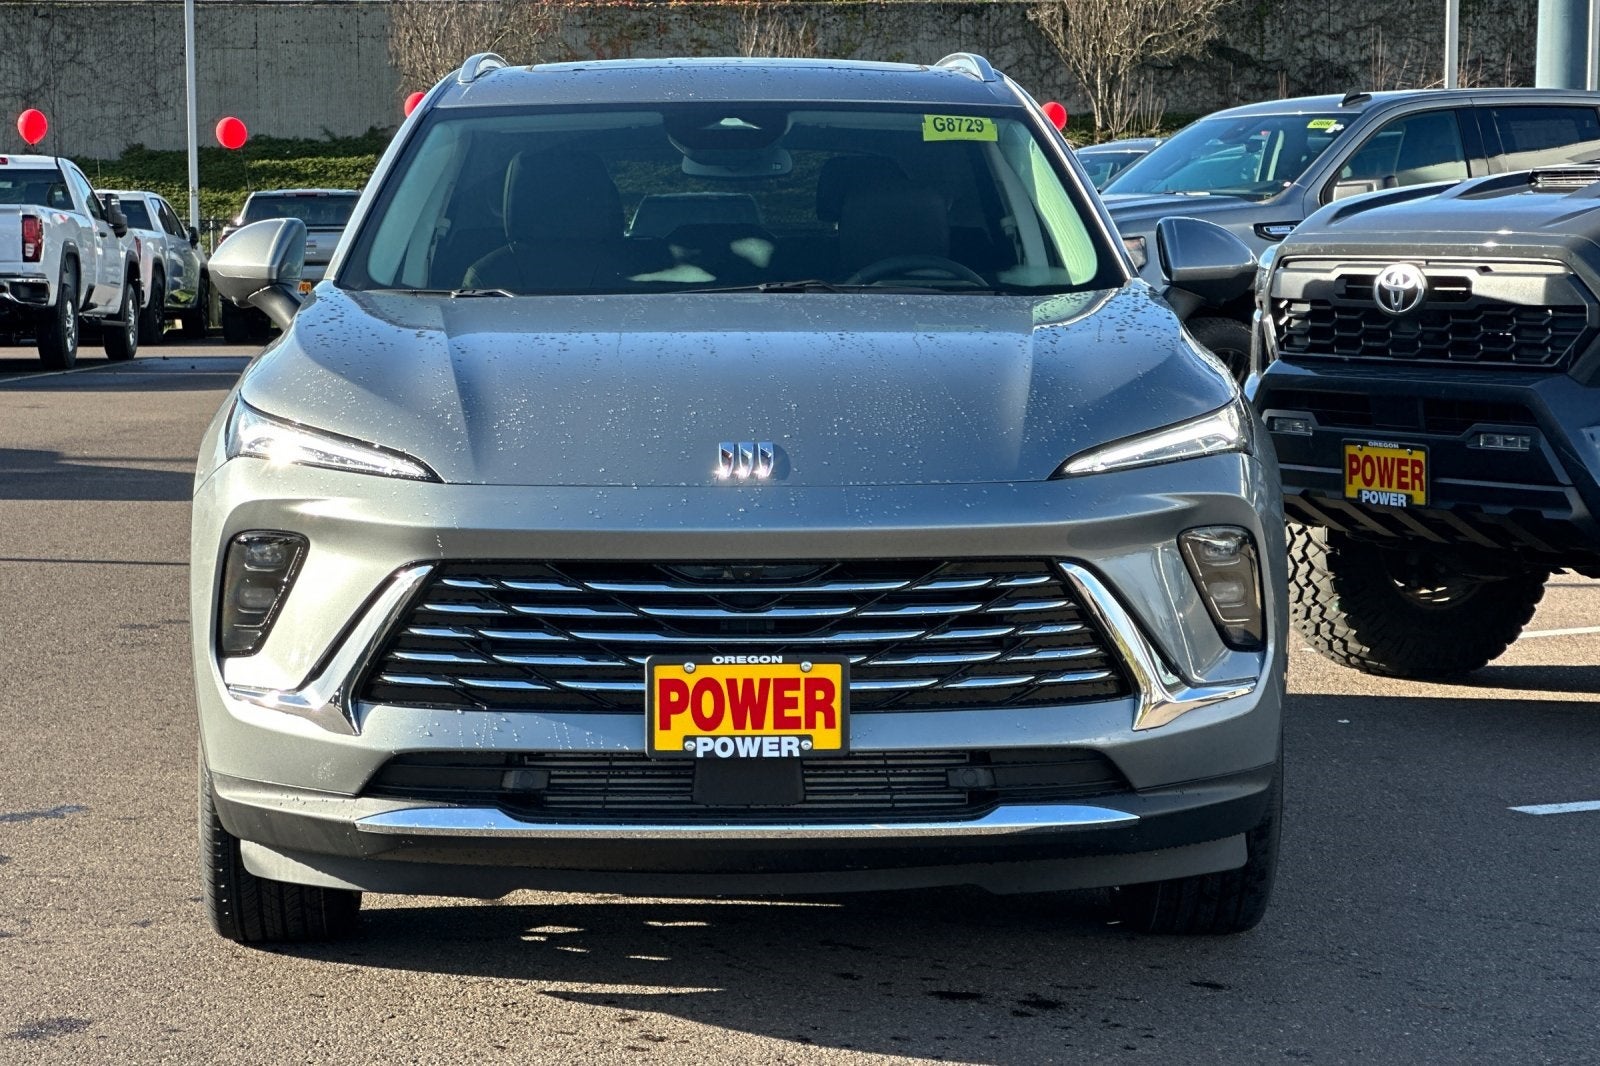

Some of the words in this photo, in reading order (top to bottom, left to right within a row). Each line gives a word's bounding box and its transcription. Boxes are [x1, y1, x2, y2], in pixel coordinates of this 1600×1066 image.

[932, 117, 984, 133] G8729
[1367, 441, 1400, 449] OREGON
[1347, 453, 1425, 492] POWER
[1361, 490, 1407, 507] POWER
[711, 655, 783, 664] OREGON
[658, 676, 837, 732] POWER
[695, 736, 800, 758] POWER
